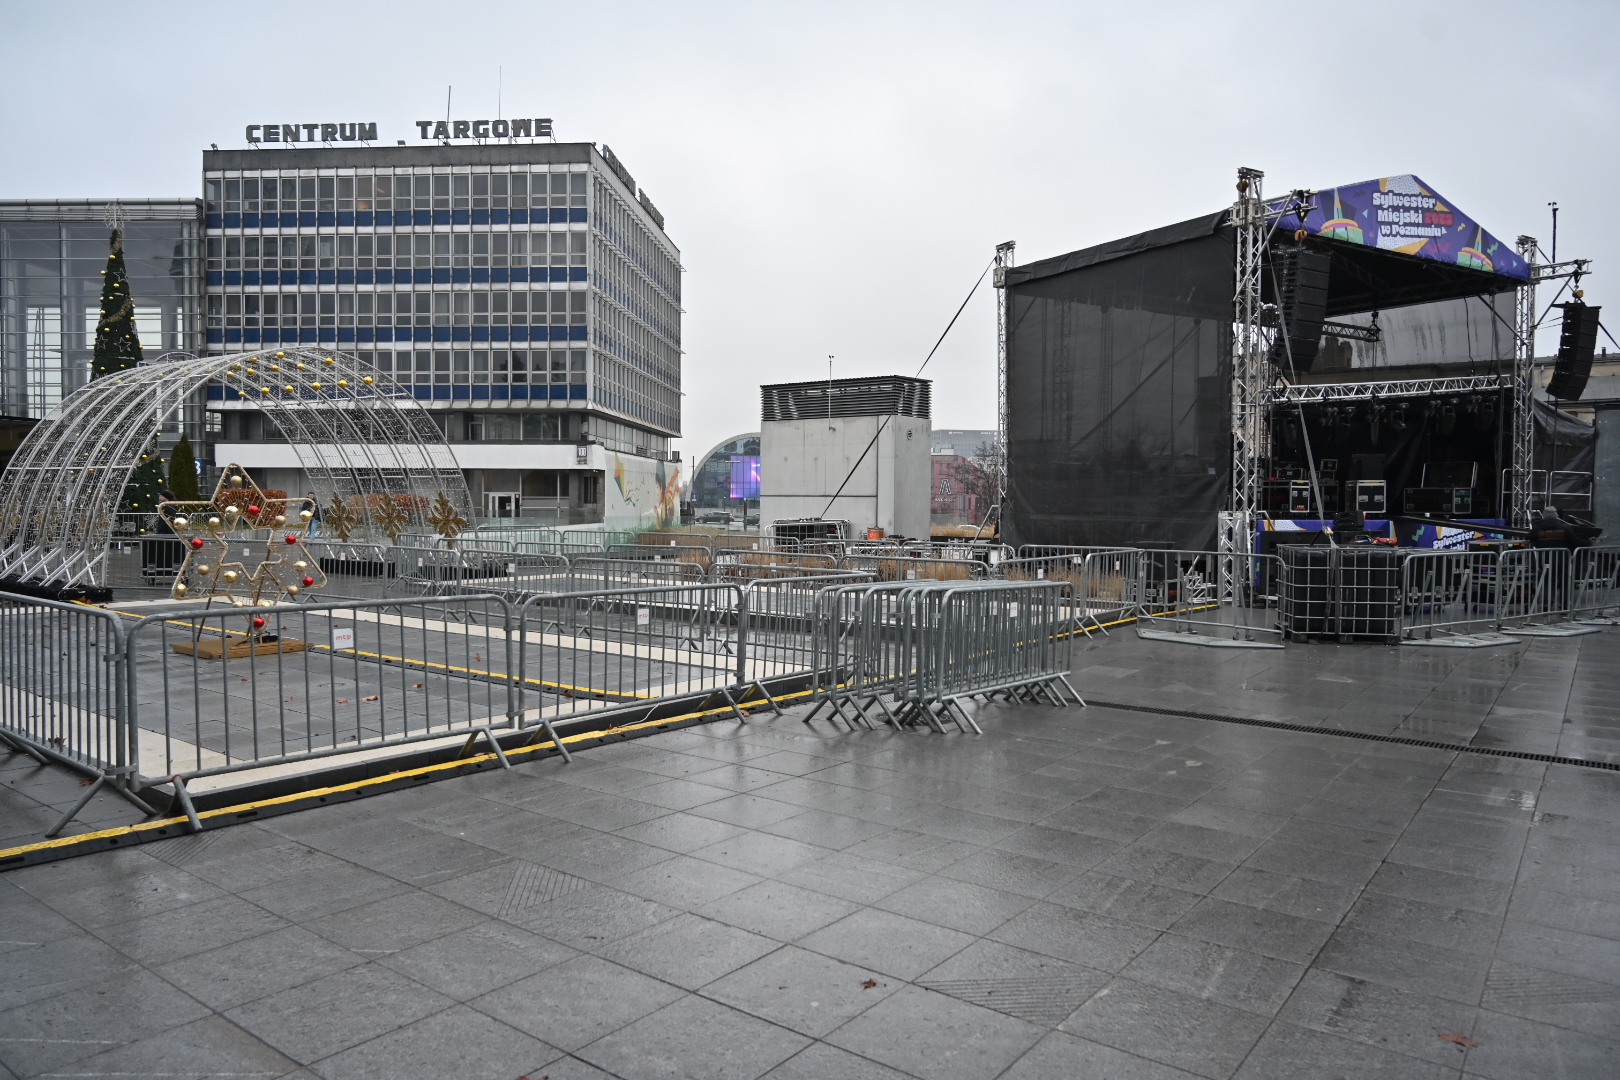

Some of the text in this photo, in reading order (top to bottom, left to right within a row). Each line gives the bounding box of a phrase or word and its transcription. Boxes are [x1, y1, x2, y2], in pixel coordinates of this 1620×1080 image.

[245, 118, 552, 143] CENTRUM TARGOWE
[1372, 192, 1436, 209] Sylwester
[1377, 208, 1454, 226] Miejski 2025
[1380, 224, 1442, 237] w Poznaniu
[1432, 530, 1475, 550] Sylwester
